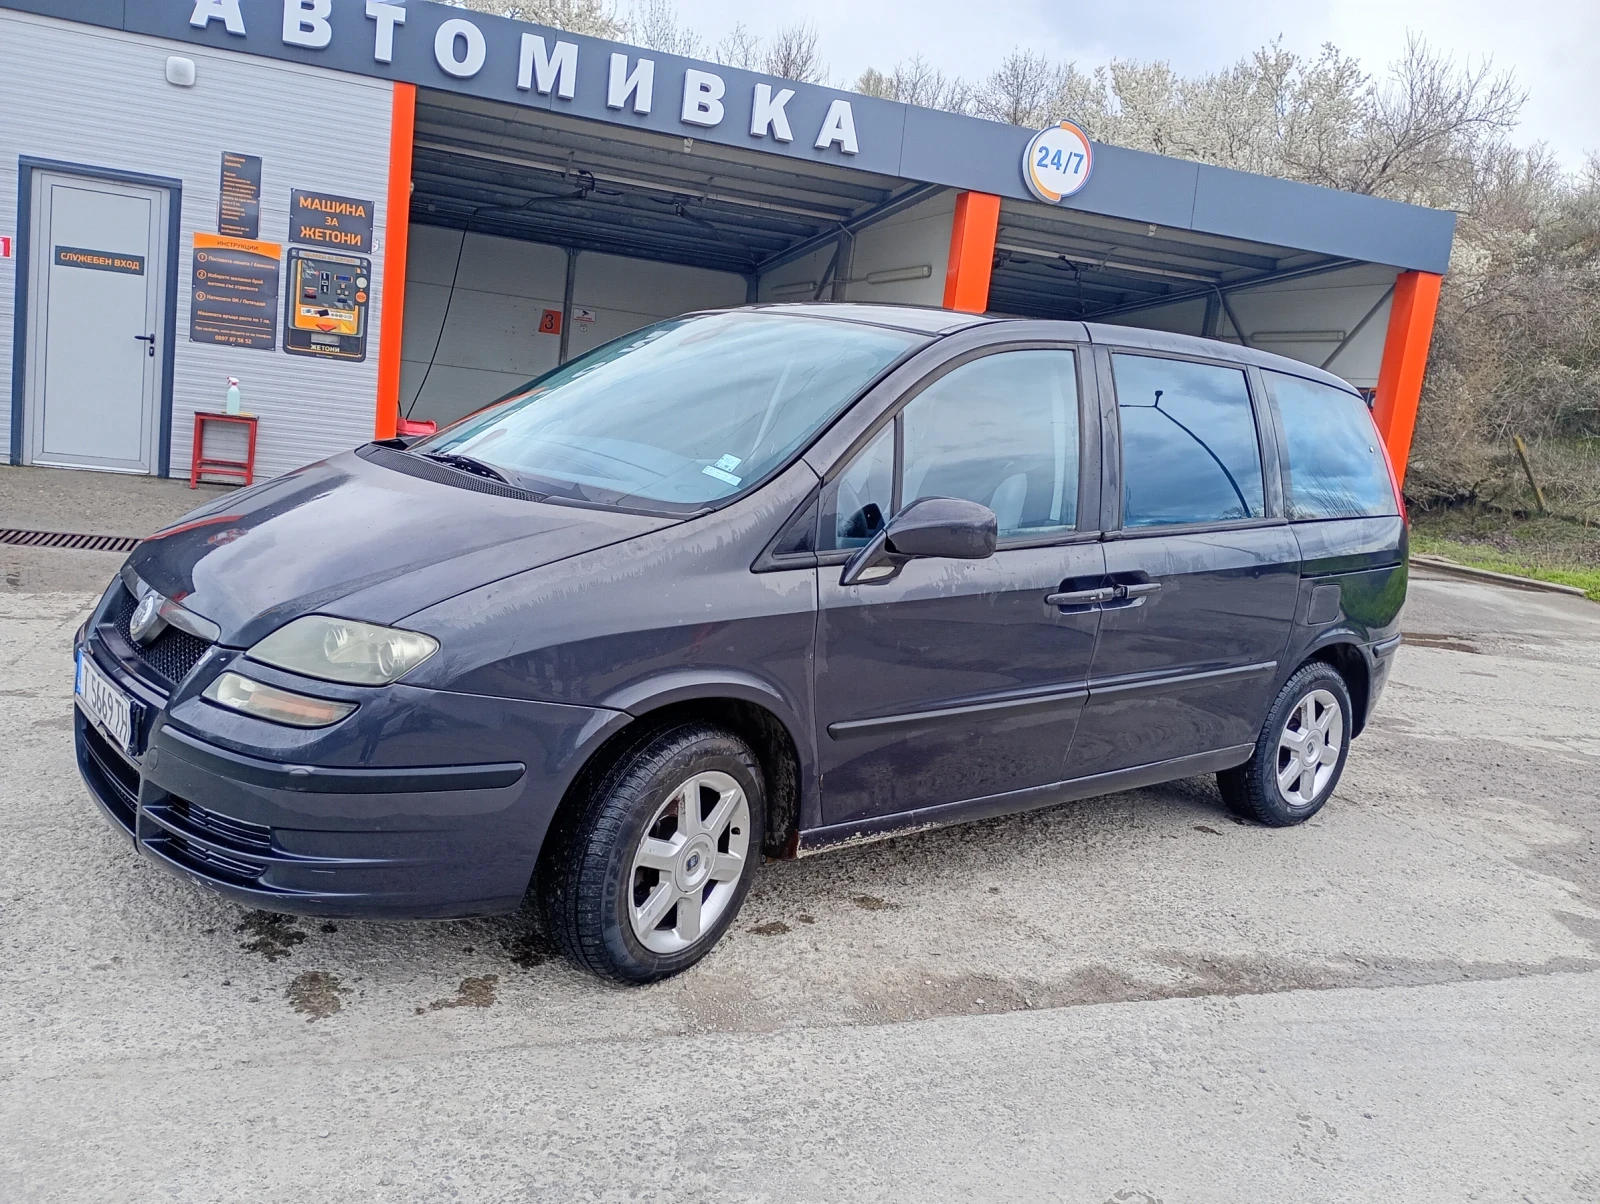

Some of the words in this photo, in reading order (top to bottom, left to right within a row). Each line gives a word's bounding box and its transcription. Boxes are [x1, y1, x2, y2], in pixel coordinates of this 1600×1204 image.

[189, 0, 859, 154] АВТОМИВКА
[1036, 146, 1084, 174] 24/7
[300, 196, 365, 217] МАШИНА
[325, 217, 338, 226] ЗА
[217, 241, 258, 250] ИНСТРУКЦИИ
[300, 226, 361, 246] ЖЕТОНИ
[60, 252, 112, 266] СЛУЖЕБЕН
[114, 259, 140, 270] ВХОД
[544, 313, 554, 330] 3
[310, 344, 340, 352] ЖЕТОНИ
[84, 664, 88, 698] T
[91, 678, 113, 726] 5669
[115, 697, 129, 743] TH
